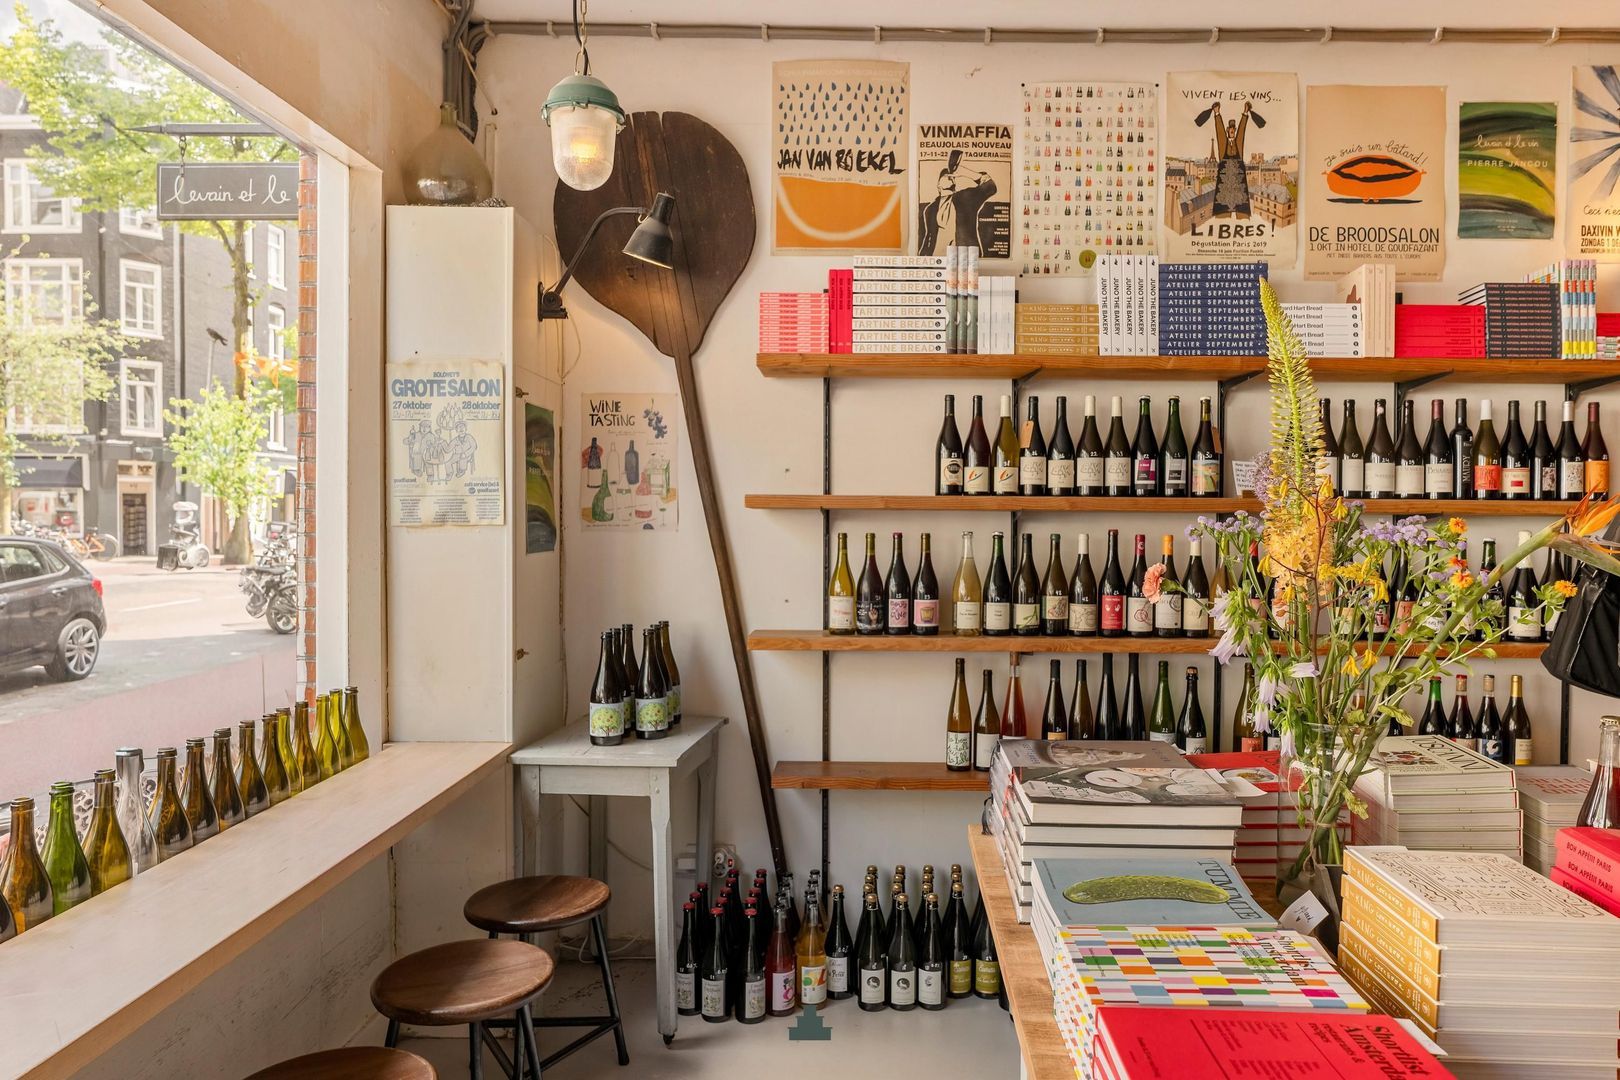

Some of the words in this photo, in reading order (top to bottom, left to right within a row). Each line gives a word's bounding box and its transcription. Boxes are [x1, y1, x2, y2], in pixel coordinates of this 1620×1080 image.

[1182, 90, 1224, 99] VIVENT
[1229, 91, 1247, 100] LES
[920, 125, 1011, 139] VINMAFFIA
[972, 141, 1012, 149] NOUVEAU
[777, 148, 802, 170] JAN
[806, 148, 831, 170] VAN
[1324, 154, 1337, 167] je
[1340, 144, 1362, 157] suis
[1368, 143, 1382, 151] un
[165, 174, 233, 204] levain
[238, 178, 256, 202] et
[261, 174, 291, 204] le
[1309, 227, 1329, 242] DE
[1337, 227, 1439, 243] BROODSALON
[1581, 225, 1613, 237] DAXIVIN
[1191, 240, 1230, 248] Dégustation
[1317, 243, 1332, 251] OKT
[1335, 243, 1345, 251] IN
[1347, 243, 1372, 252] HOTEL
[1375, 244, 1385, 252] DE
[1388, 243, 1439, 252] GOUDFAZANT
[1581, 238, 1604, 246] ZONDAG
[854, 283, 897, 291] TARTINE
[901, 283, 934, 291] BREAD
[391, 379, 446, 397] GROTE
[447, 379, 500, 397] SALON
[1462, 455, 1471, 482] MAURY
[1567, 842, 1577, 852] BON
[1597, 859, 1611, 872] PARIS
[1568, 862, 1578, 872] BON
[1598, 879, 1613, 893] PARIS
[1255, 936, 1308, 986] Amsterdam
[1272, 935, 1319, 971] Shortlist
[1366, 1025, 1432, 1075] Shortlist
